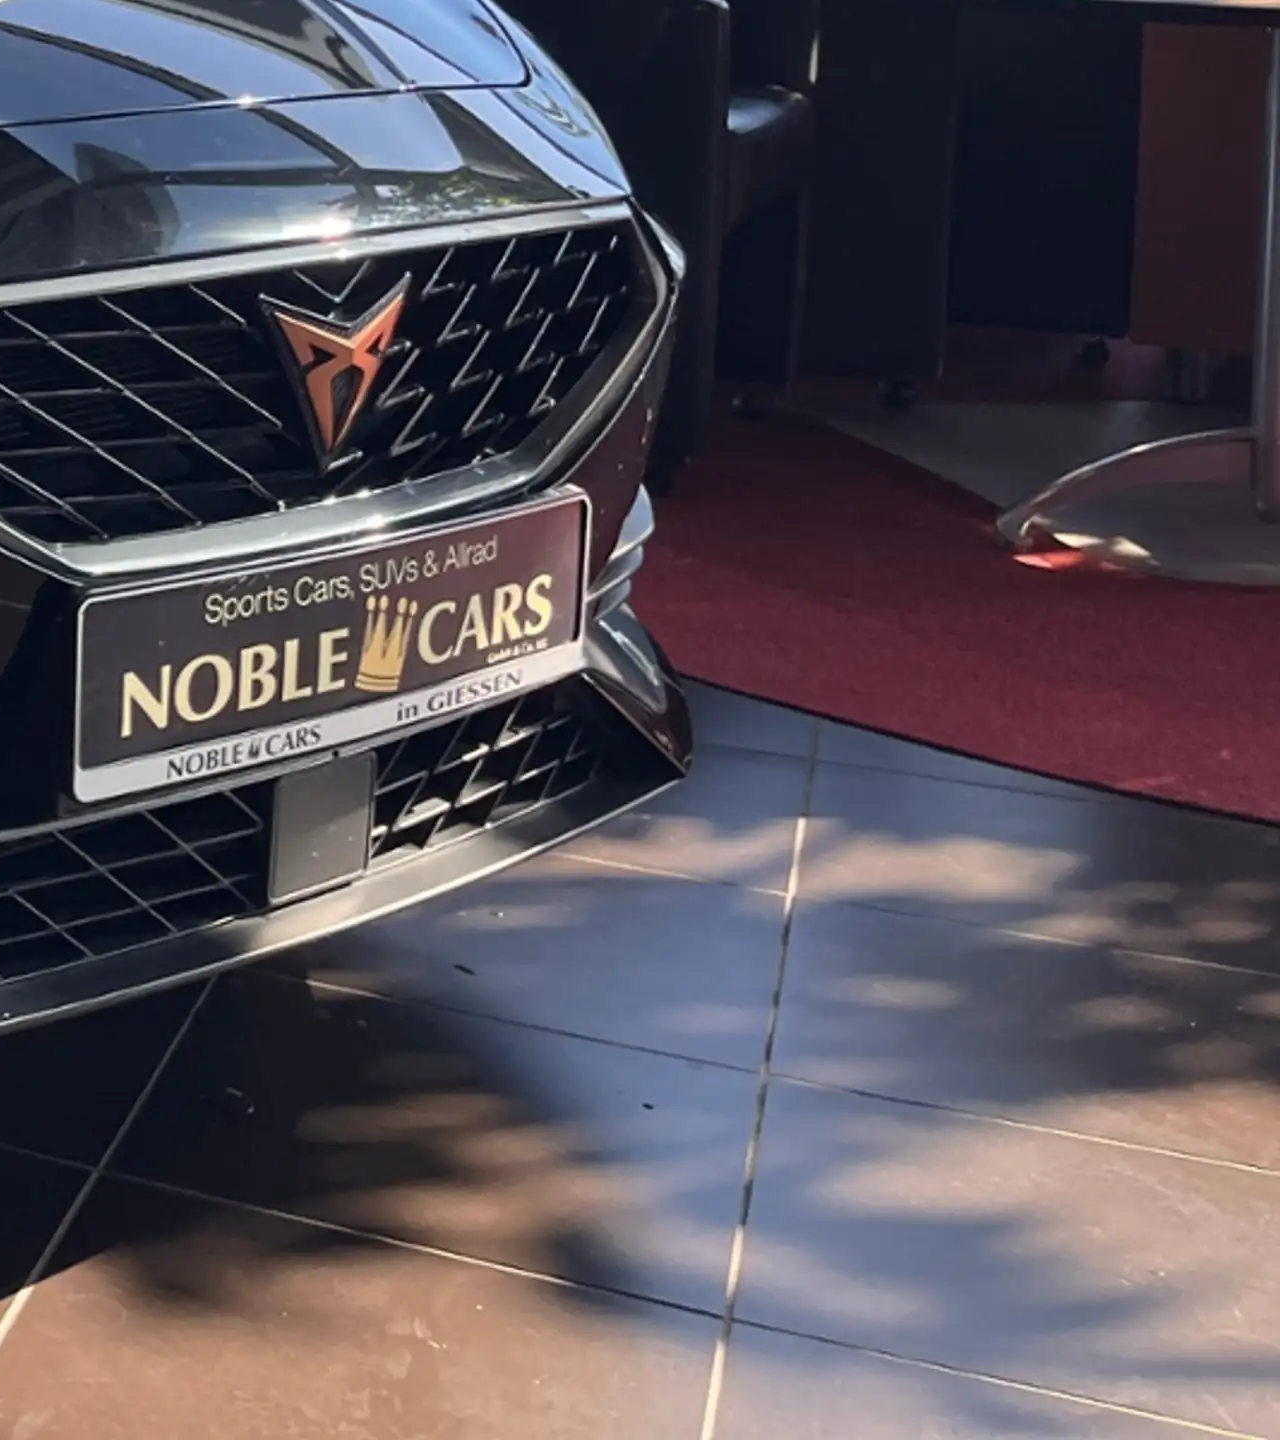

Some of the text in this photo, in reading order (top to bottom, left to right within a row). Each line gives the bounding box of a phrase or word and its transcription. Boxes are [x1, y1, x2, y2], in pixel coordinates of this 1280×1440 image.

[204, 535, 498, 628] Sports Cars, SUVs & Allrad
[121, 573, 553, 738] NOBLE CARS
[166, 668, 522, 780] NOBLE CARS in GIESSEN
